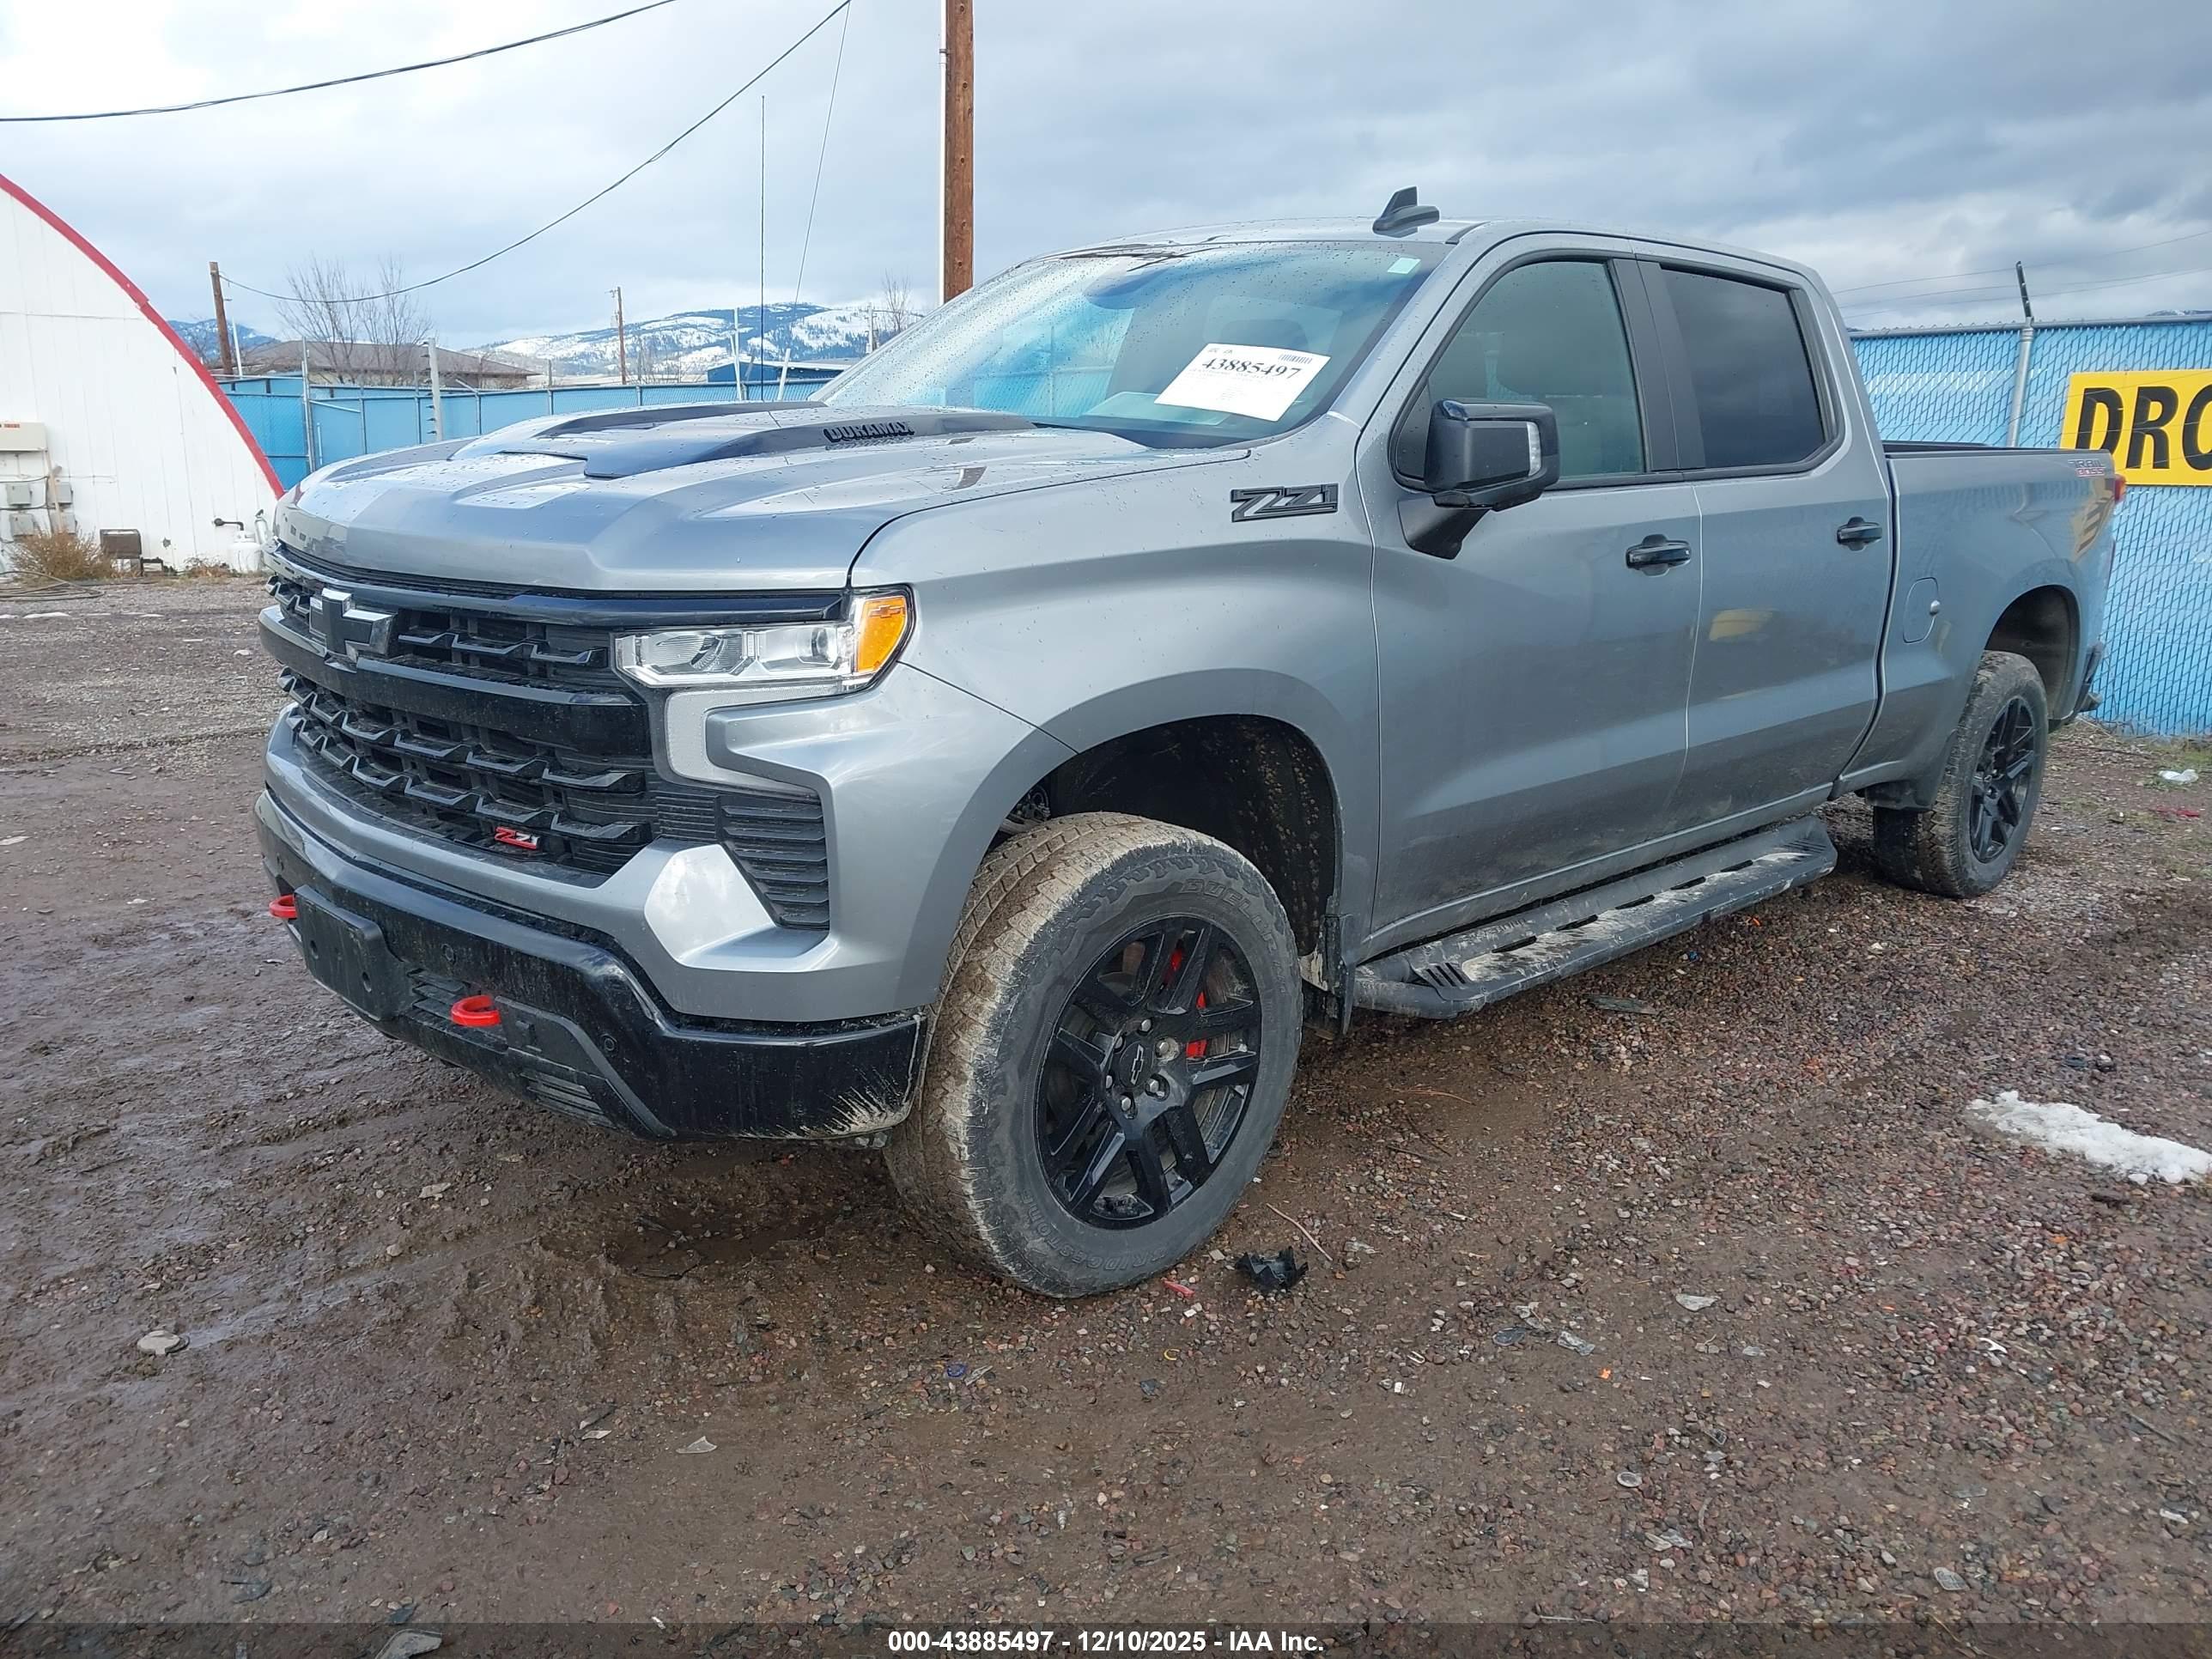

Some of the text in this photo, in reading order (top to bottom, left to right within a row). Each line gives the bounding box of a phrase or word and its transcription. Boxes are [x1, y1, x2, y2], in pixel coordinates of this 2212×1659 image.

[1201, 358, 1304, 379] 43885497
[823, 422, 915, 442] DURAMAX
[1231, 483, 1339, 522] Z71
[494, 826, 539, 850] Z71
[1021, 1188, 1169, 1271] BRIDGESTONE
